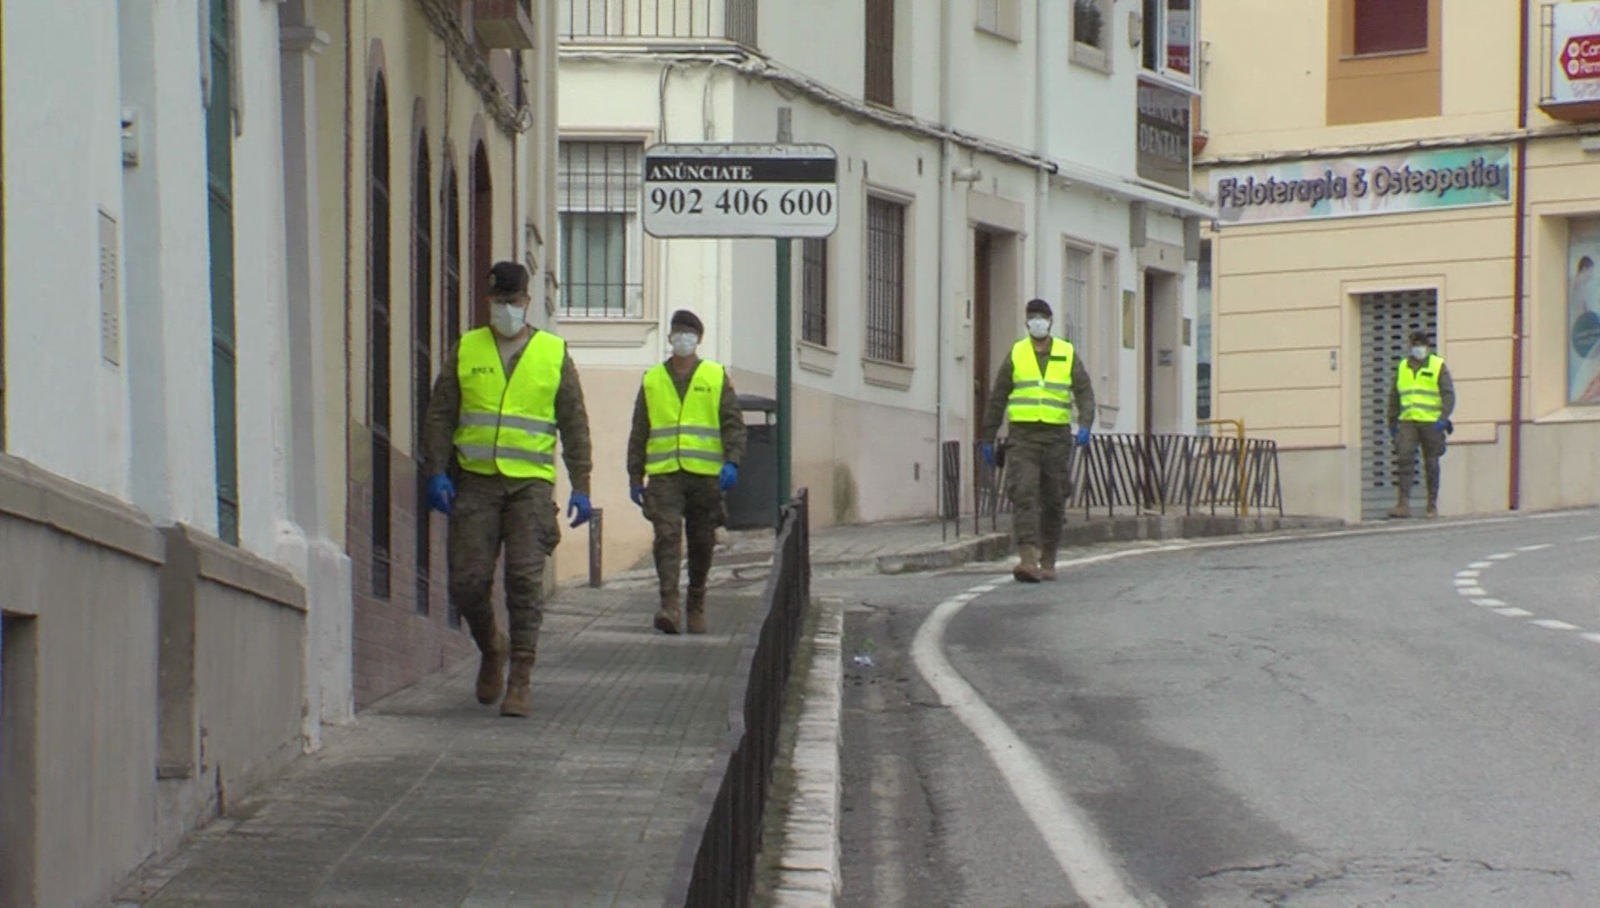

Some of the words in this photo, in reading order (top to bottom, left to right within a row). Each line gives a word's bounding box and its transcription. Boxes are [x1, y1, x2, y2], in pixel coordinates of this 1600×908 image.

[650, 162, 753, 180] ANÚNCIATE
[1218, 168, 1348, 208] Fisioterapia
[1351, 167, 1368, 198] &
[651, 188, 703, 215] 902
[715, 188, 768, 215] 406
[780, 188, 832, 216] 600
